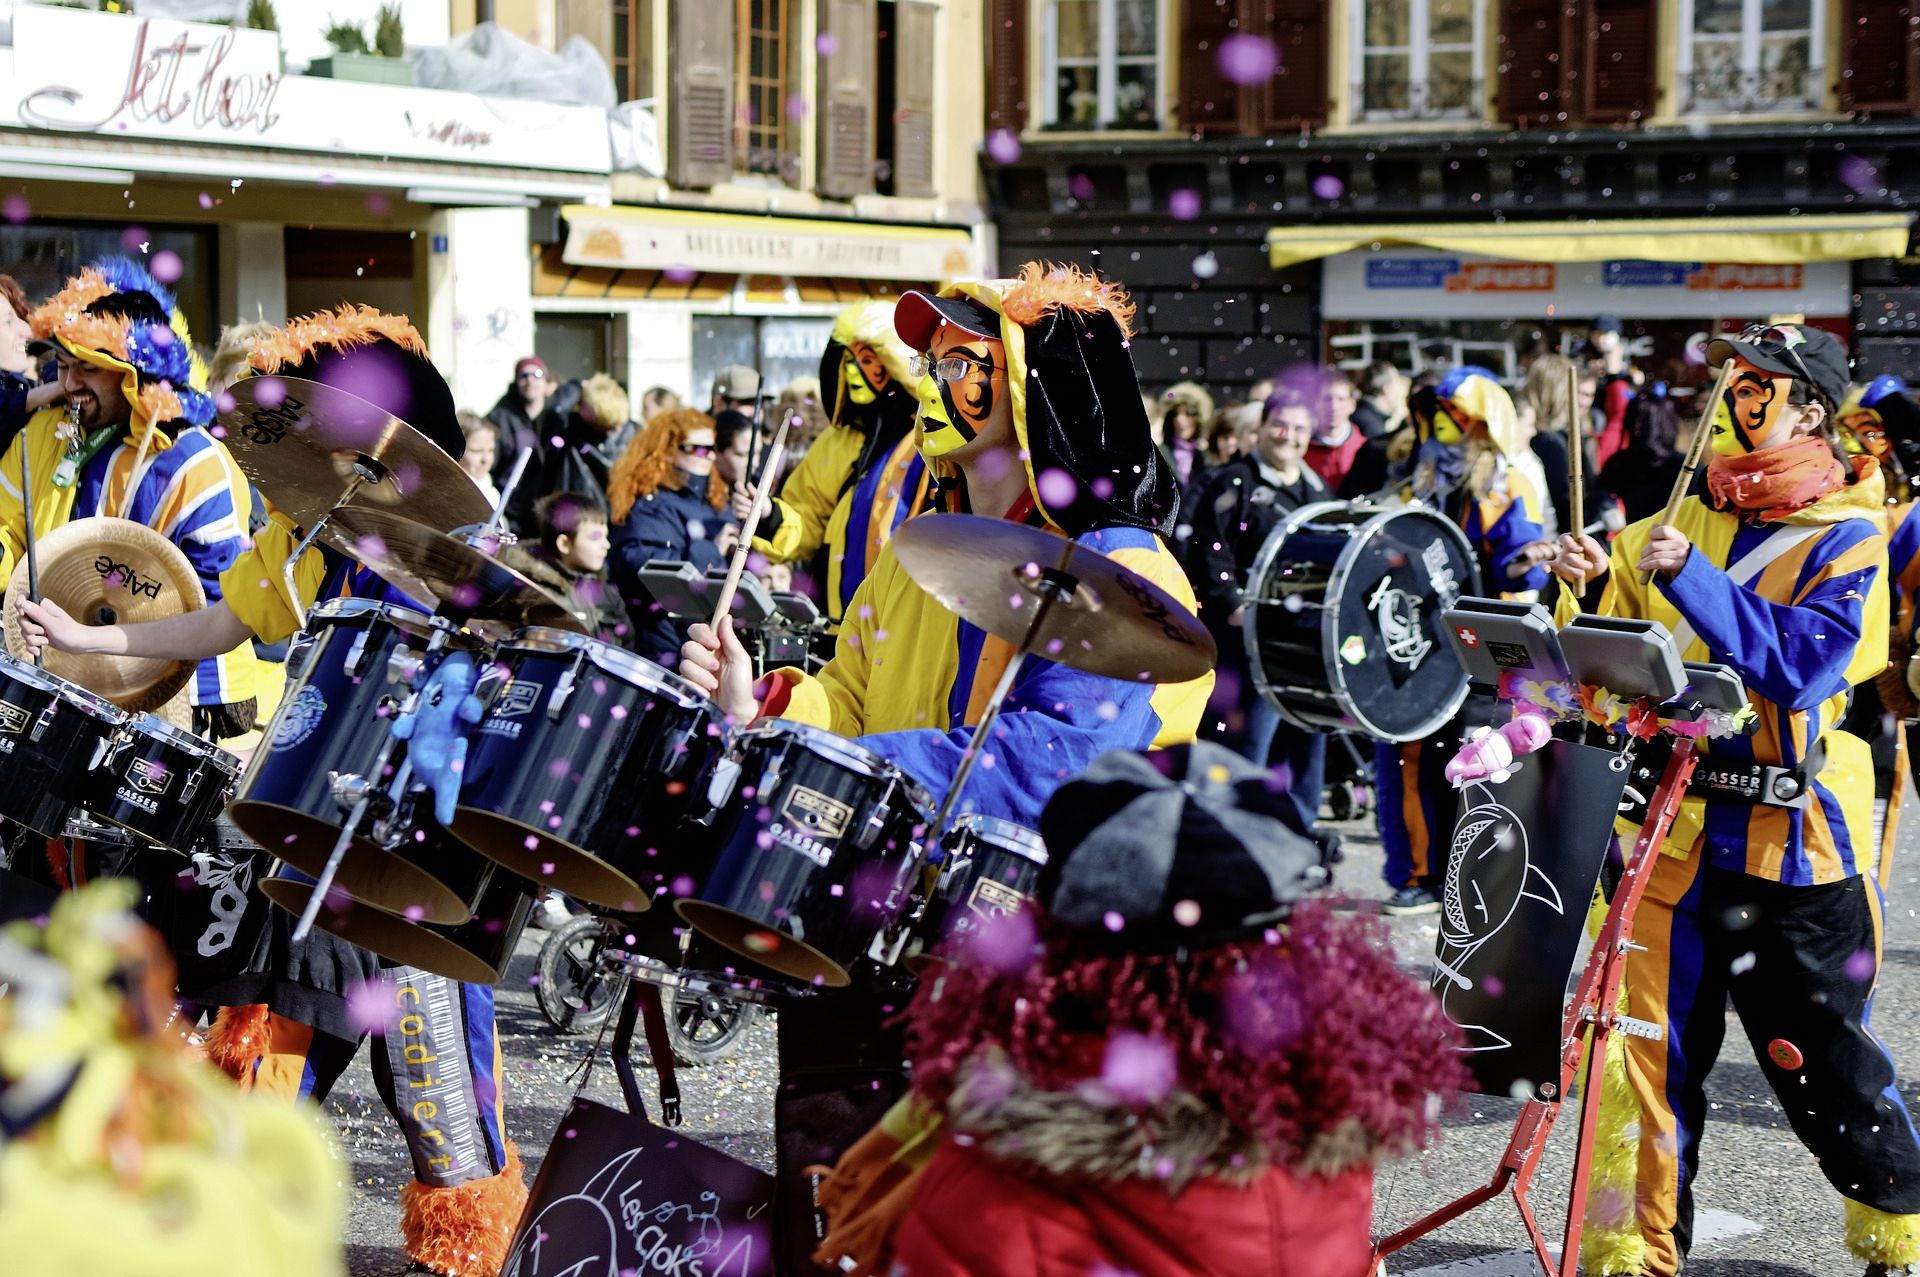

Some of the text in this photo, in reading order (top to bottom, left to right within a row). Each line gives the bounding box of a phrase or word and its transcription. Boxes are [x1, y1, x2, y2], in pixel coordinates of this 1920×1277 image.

[117, 786, 158, 810] GASSER
[1695, 769, 1761, 789] GASSER
[396, 986, 454, 1171] codiert
[618, 1179, 643, 1231] Les
